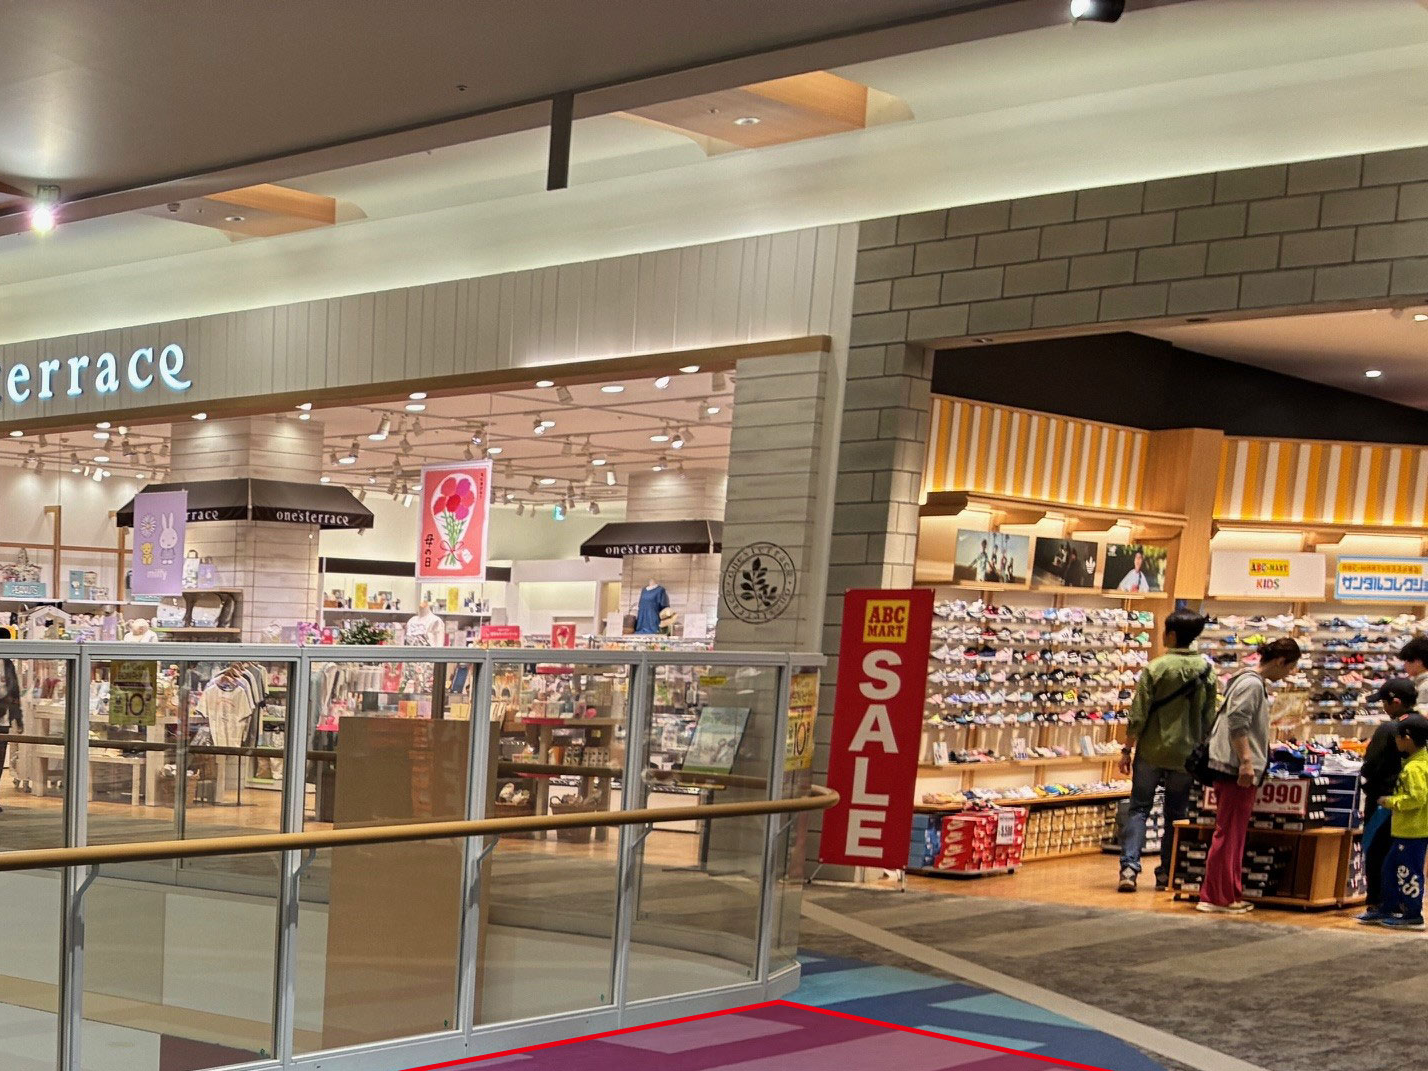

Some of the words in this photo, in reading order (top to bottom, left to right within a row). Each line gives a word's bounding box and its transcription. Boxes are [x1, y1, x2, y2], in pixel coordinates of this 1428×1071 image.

[1255, 578, 1281, 590] KIDS
[868, 605, 906, 624] ABC
[867, 624, 904, 638] MART
[844, 649, 903, 859] SALE
